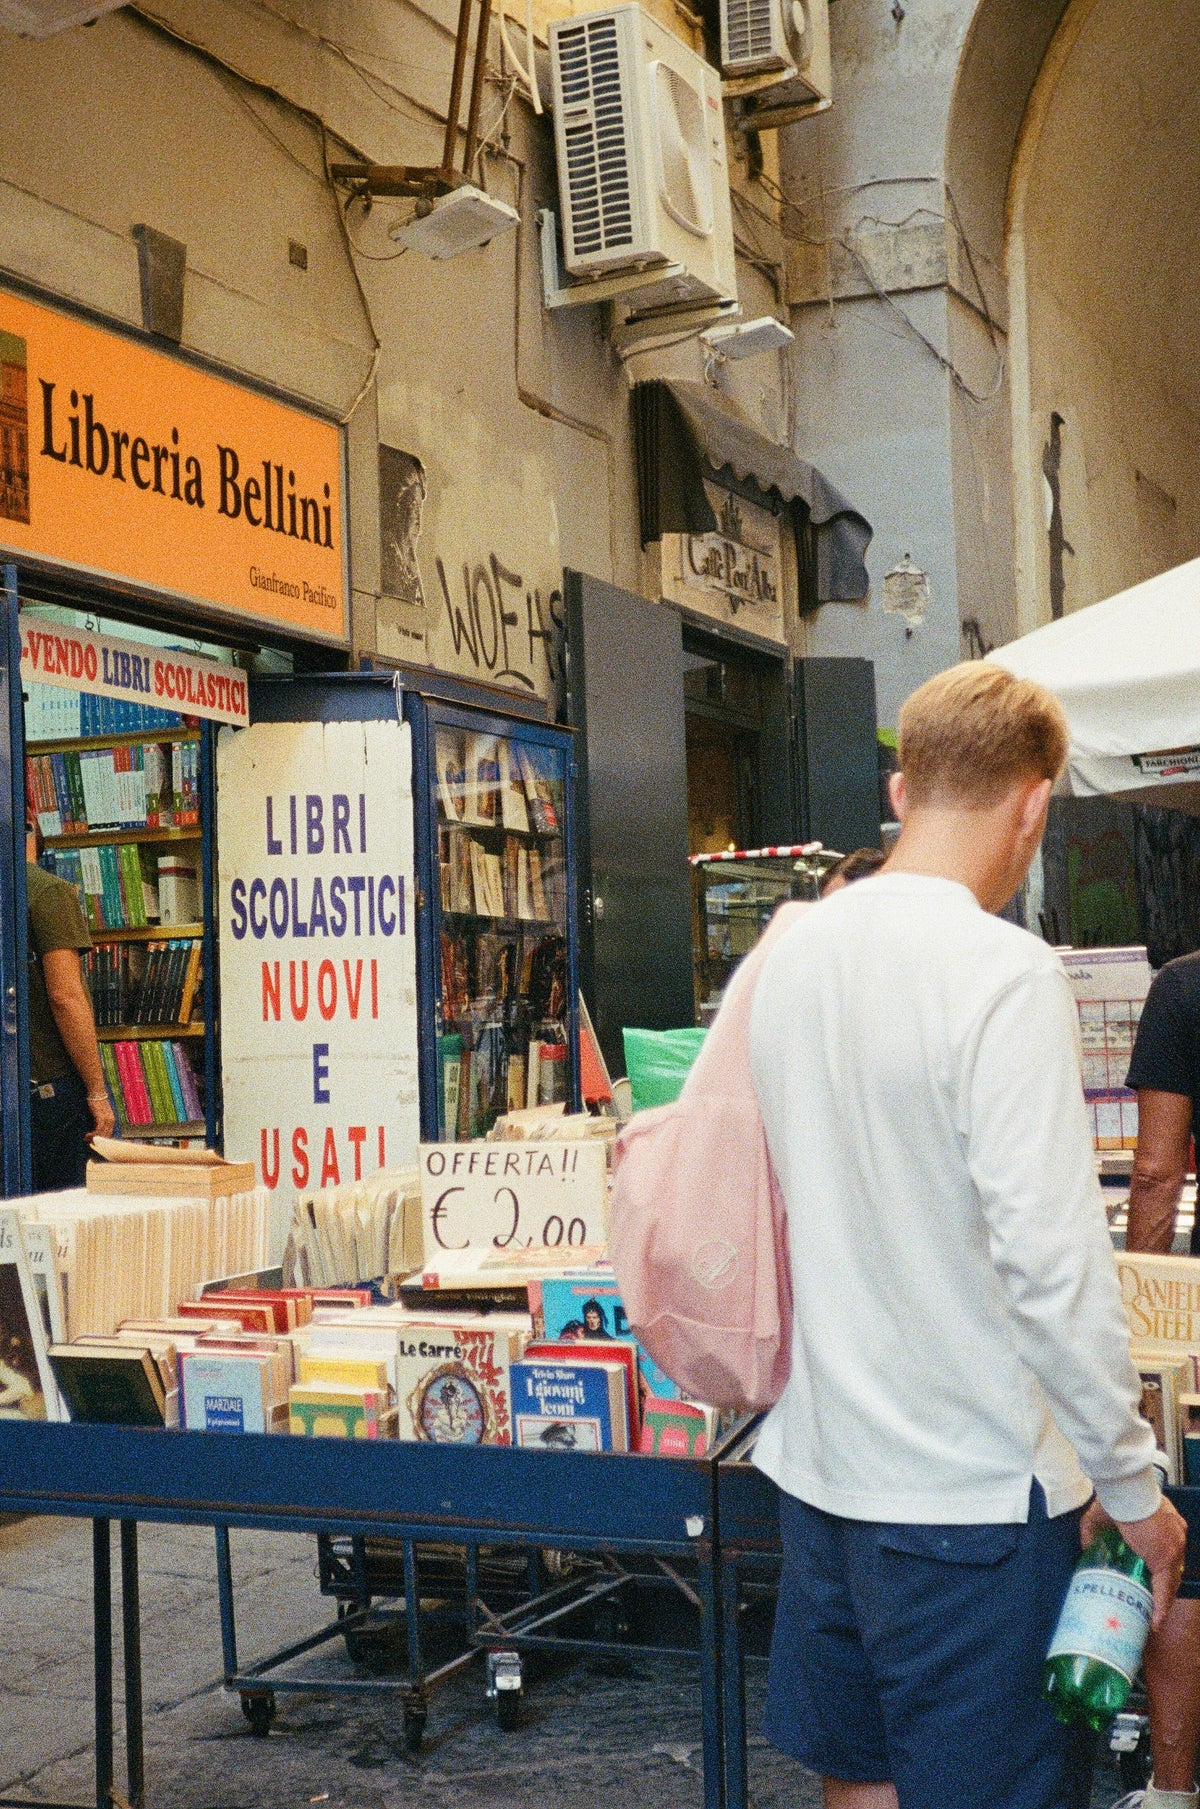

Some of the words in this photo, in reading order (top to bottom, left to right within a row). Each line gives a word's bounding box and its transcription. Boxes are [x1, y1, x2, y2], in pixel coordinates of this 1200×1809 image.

[38, 378, 205, 508] Libreria
[217, 444, 334, 549] Bellini
[249, 566, 300, 599] Gianfranco
[302, 581, 337, 609] Pacifico
[102, 647, 151, 692] LIBRI
[154, 660, 247, 715] SCOLASTICI
[266, 793, 366, 855] LIBRI
[231, 875, 406, 940] SCOLASTICI
[261, 959, 379, 1021] NUOVI
[312, 1043, 331, 1104] E
[260, 1125, 386, 1190] USATI
[426, 1148, 579, 1183] OFFERTA!!
[1129, 1297, 1199, 1341] STEEL
[400, 1341, 416, 1357] Le
[418, 1341, 461, 1359] Carré
[535, 1380, 585, 1405] giovani
